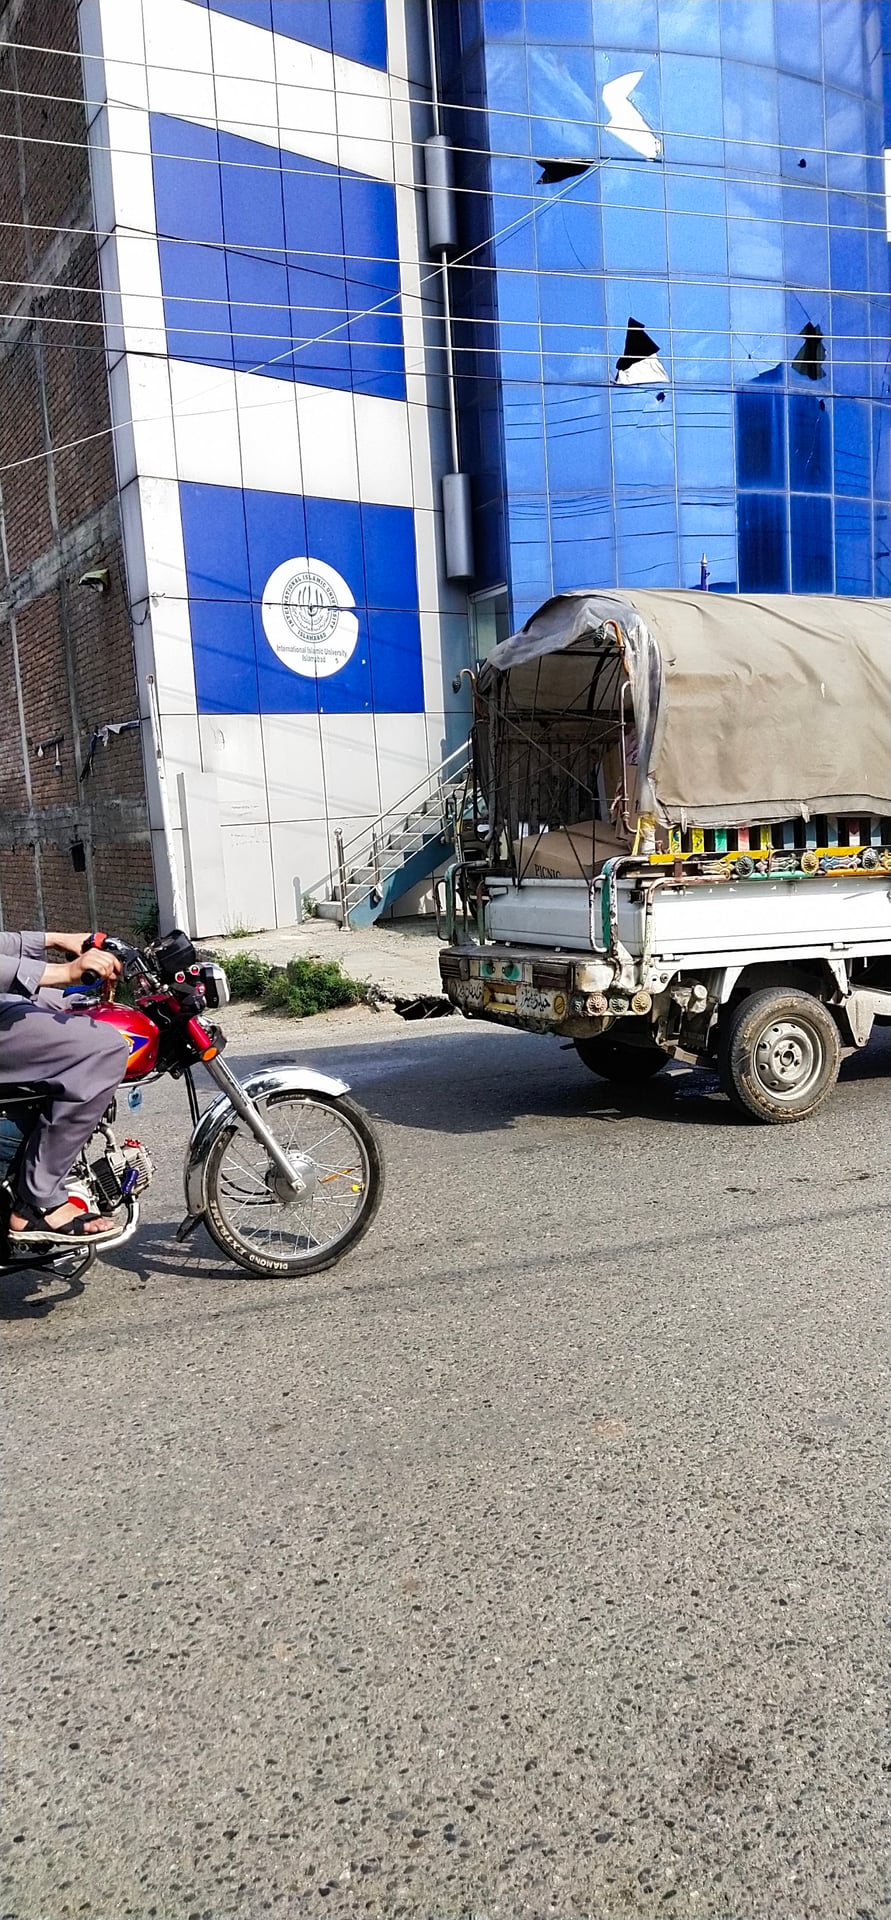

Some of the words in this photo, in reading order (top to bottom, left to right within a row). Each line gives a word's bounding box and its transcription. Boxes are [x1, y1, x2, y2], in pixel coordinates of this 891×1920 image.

[302, 574, 327, 588] ISLAMIC
[297, 630, 327, 641] ISLAMABAD
[276, 643, 307, 654] International
[306, 646, 324, 655] Islamic
[534, 863, 561, 879] PICNIC
[209, 1199, 247, 1256] EXTREME
[248, 1254, 289, 1270] DIAMOND
